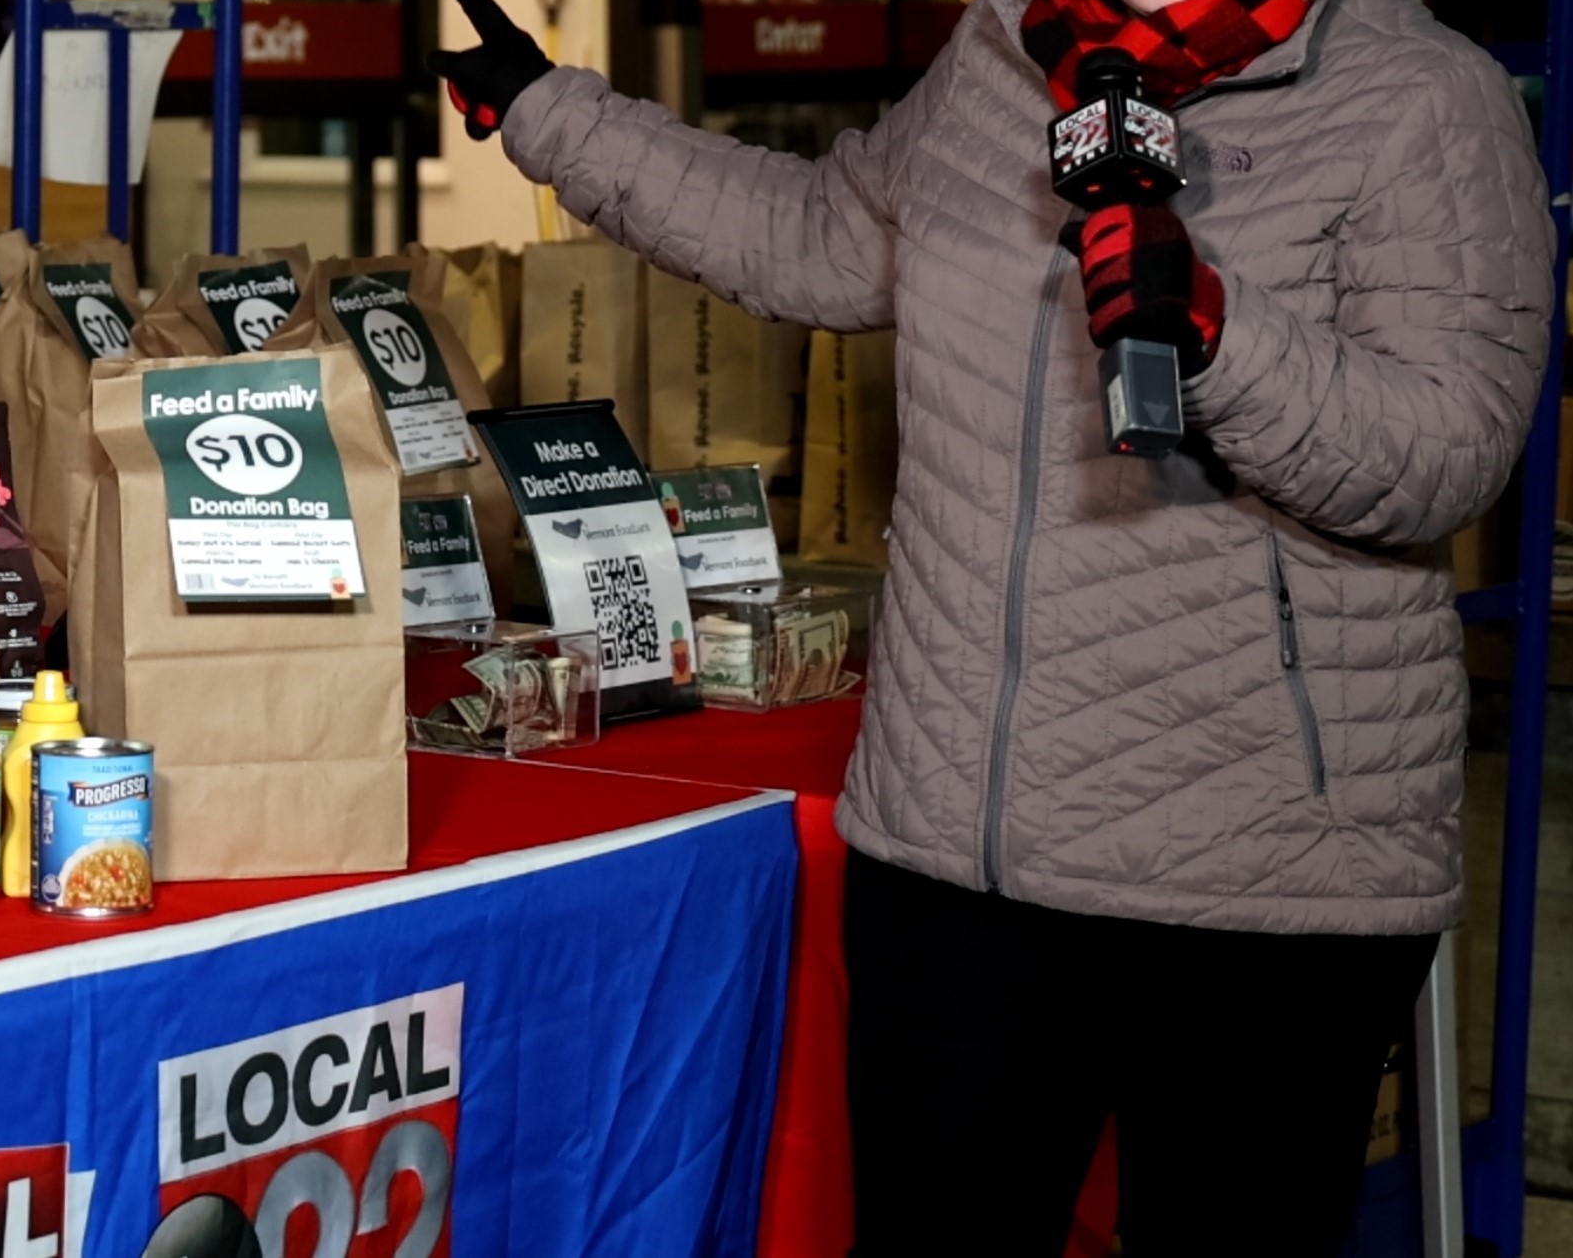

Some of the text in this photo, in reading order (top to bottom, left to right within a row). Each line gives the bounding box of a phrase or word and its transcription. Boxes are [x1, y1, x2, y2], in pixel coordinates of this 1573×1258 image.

[1058, 104, 1102, 135] LOCAL
[200, 275, 297, 302] Feed a Family
[331, 295, 364, 313] Feed
[370, 290, 410, 306] Family
[82, 313, 130, 354] $10
[370, 325, 421, 371] $10
[150, 384, 318, 418] Feed a Family
[195, 432, 295, 473] $10
[533, 439, 600, 463] Make a
[520, 465, 643, 499] Direct Donation
[189, 496, 330, 519] Donation Bag
[684, 503, 758, 523] Feed a Family
[408, 534, 470, 555] Feed a Family
[75, 776, 146, 806] PROGRESSO
[180, 1011, 450, 1164] LOCAL
